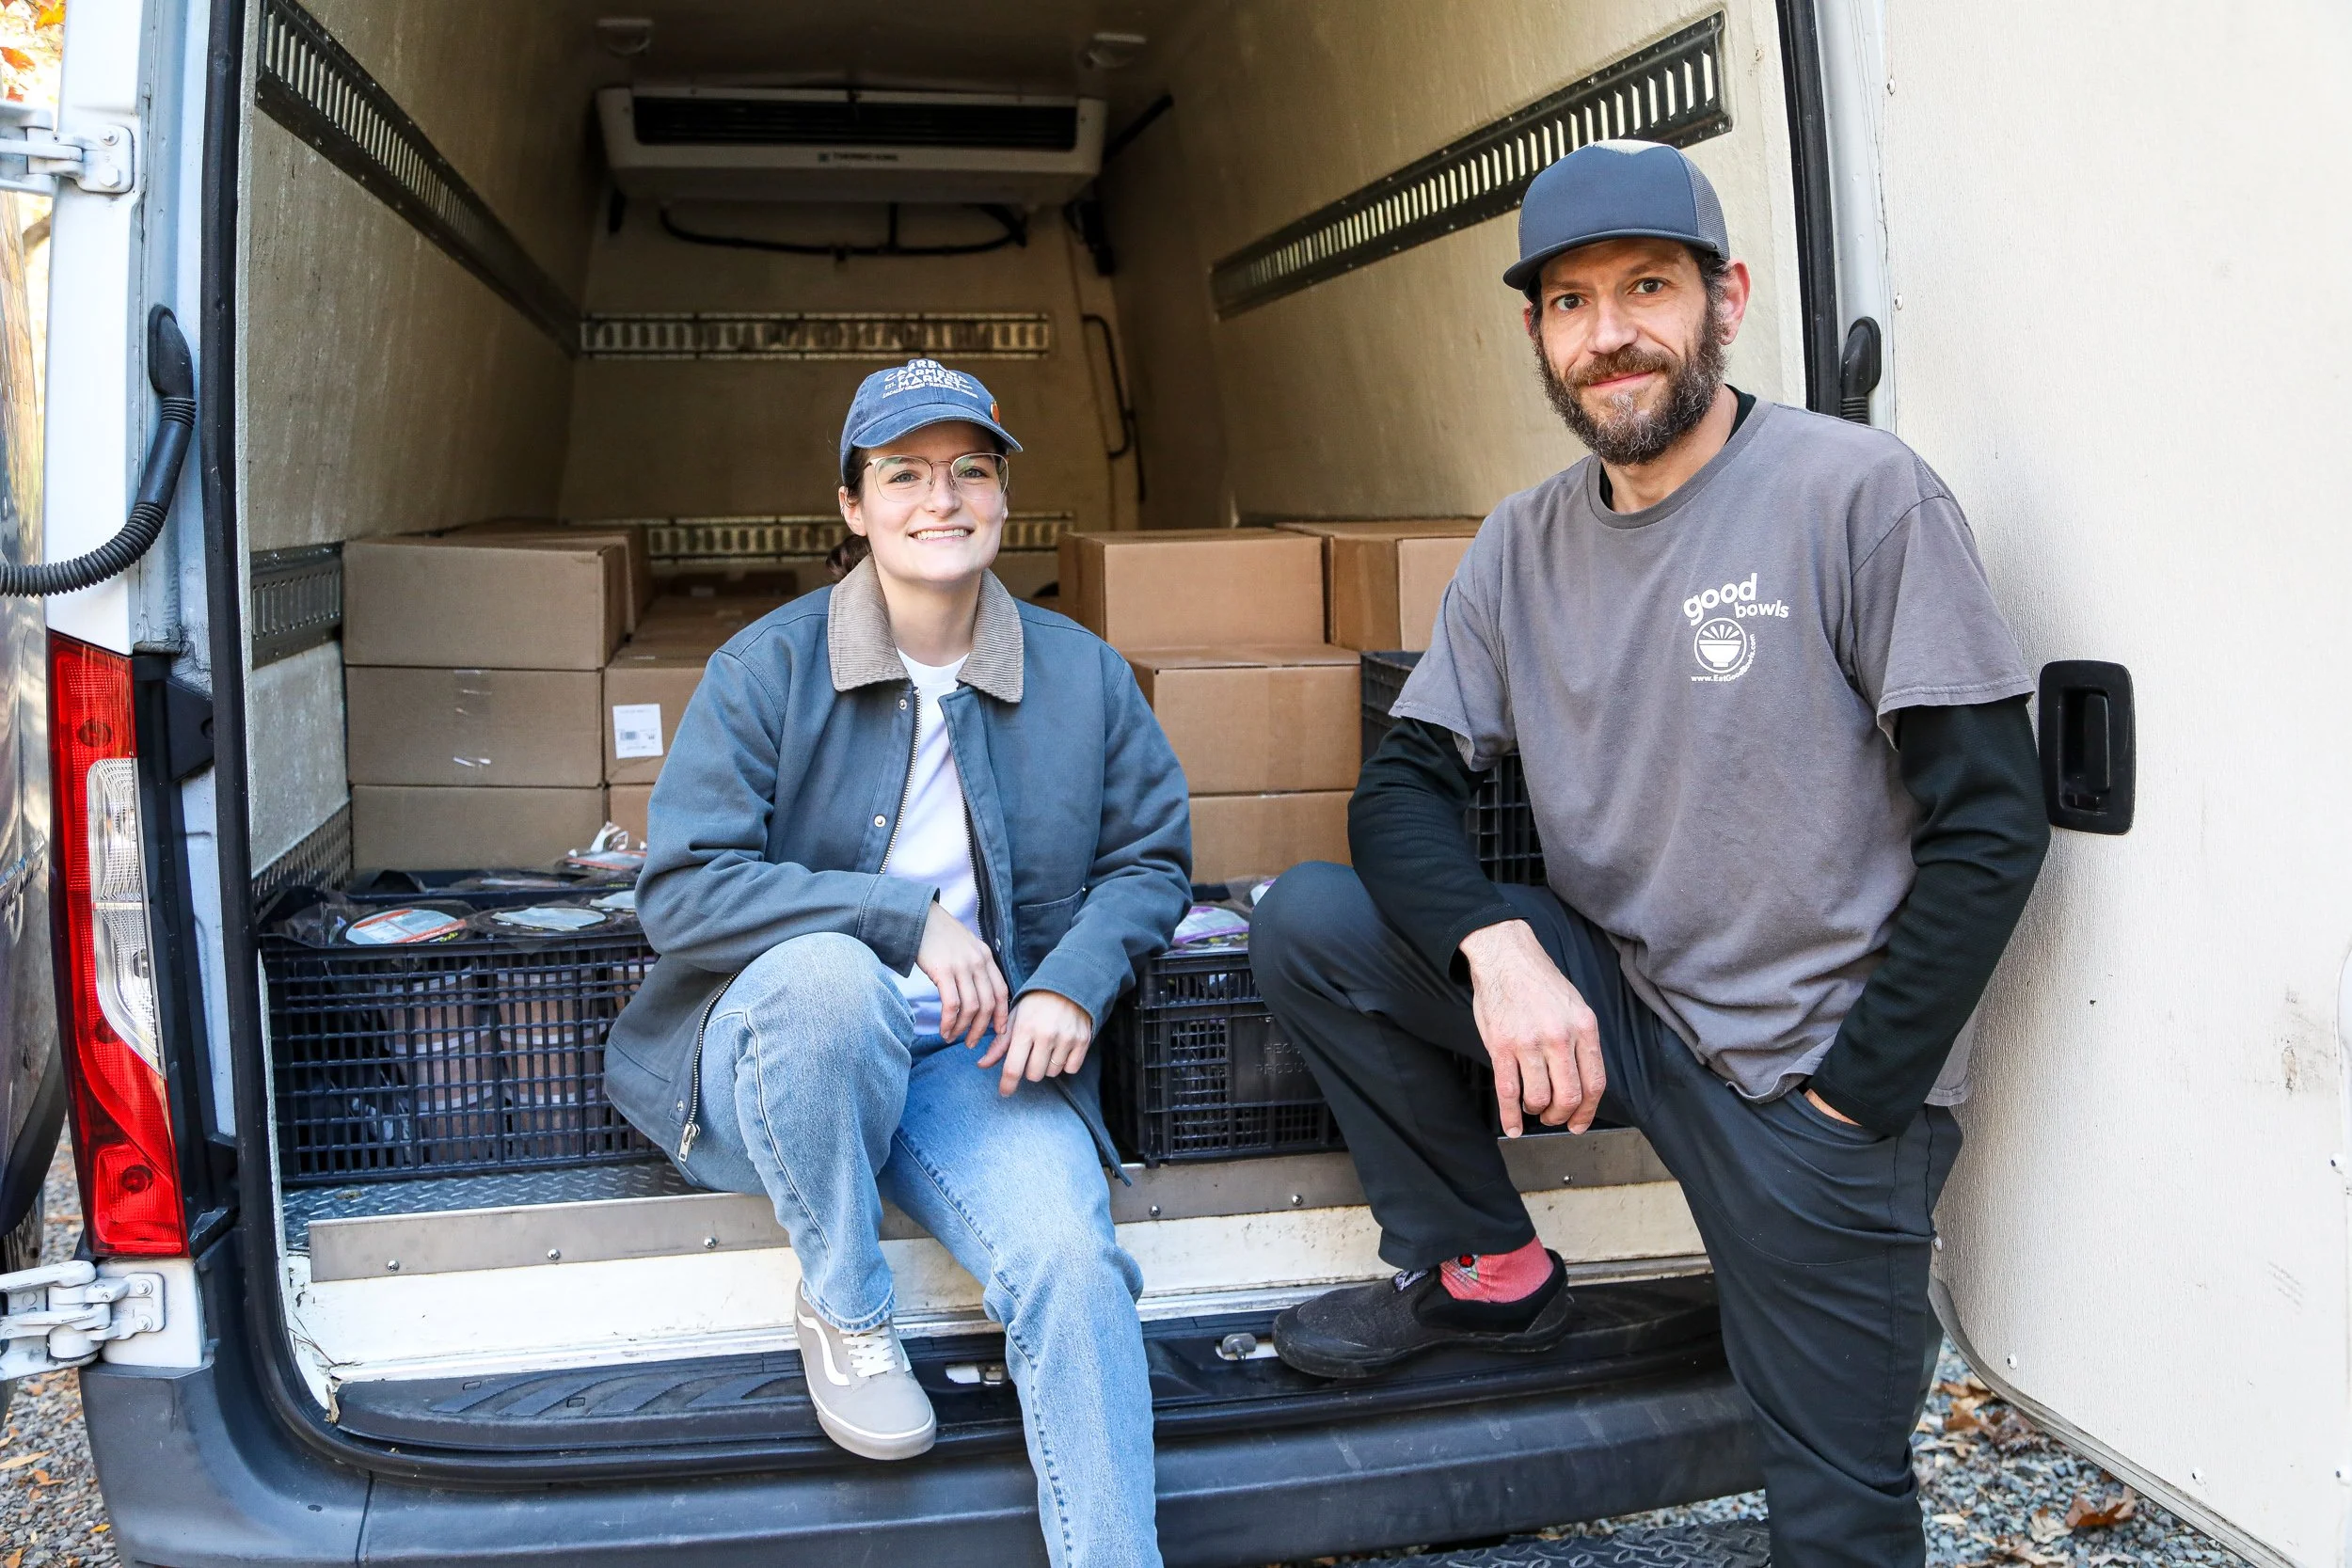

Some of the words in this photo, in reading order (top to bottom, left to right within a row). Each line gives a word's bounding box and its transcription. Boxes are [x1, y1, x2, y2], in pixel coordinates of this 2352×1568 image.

[1683, 572, 1757, 626] good
[1734, 599, 1789, 619] bowls
[1691, 633, 1756, 682] www.EatGoodBowls.com
